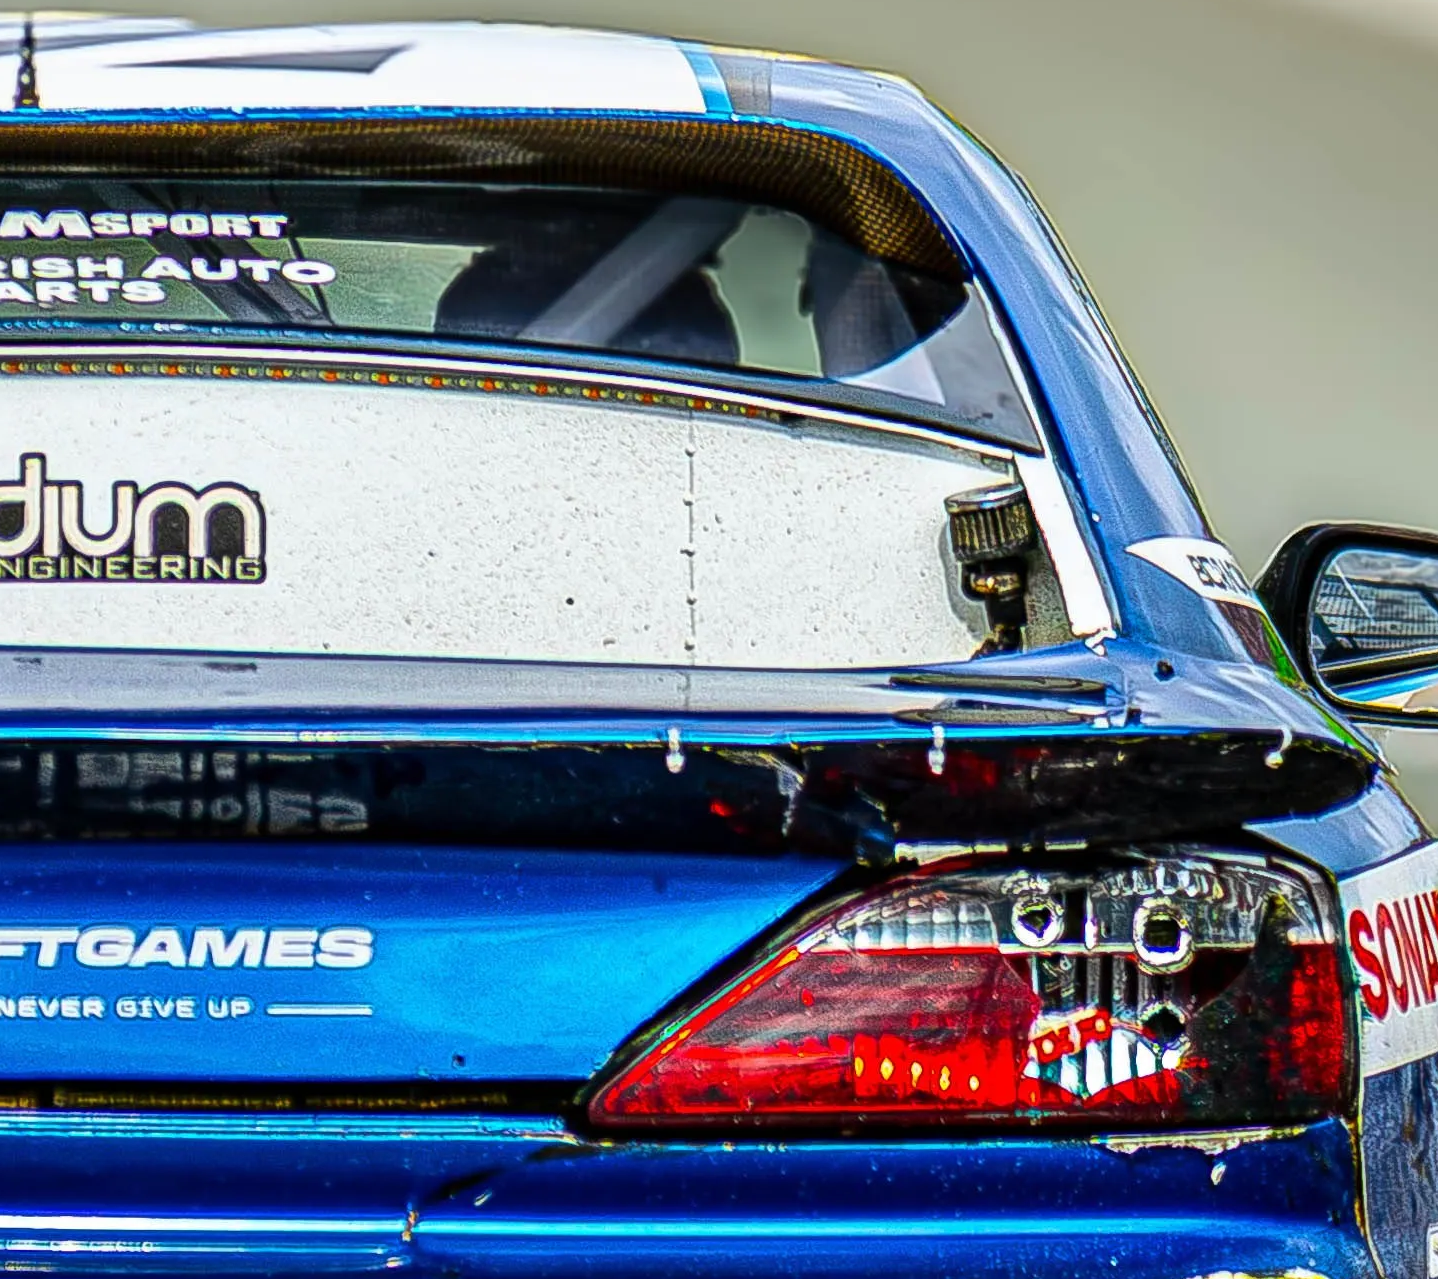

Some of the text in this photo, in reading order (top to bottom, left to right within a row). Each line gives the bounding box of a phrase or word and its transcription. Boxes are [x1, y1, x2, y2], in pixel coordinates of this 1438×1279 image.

[141, 256, 337, 285] AUTO
[116, 995, 198, 1019] GIVE
[207, 995, 253, 1019] UP
